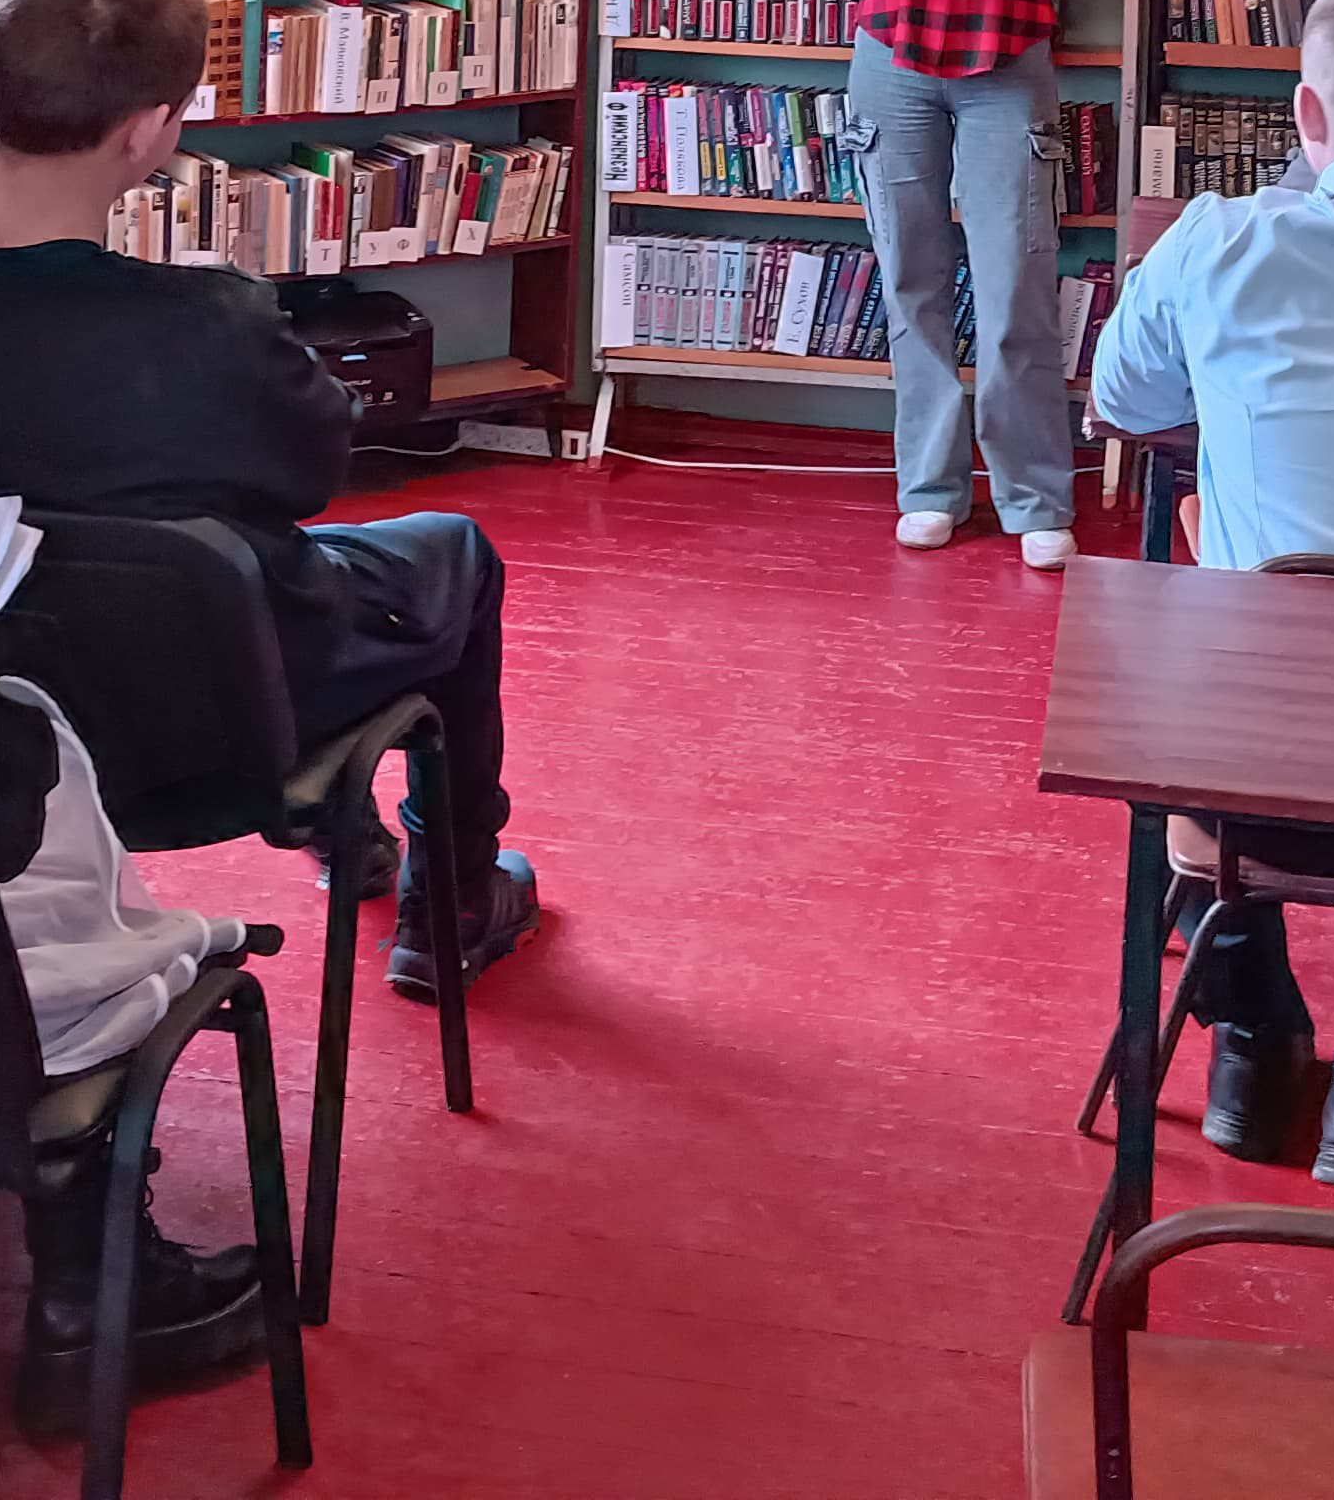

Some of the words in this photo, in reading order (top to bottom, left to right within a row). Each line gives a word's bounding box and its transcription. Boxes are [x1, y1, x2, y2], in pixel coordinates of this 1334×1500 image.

[334, 27, 351, 105] Маяковский
[606, 102, 629, 111] Ф
[604, 114, 629, 182] Незнанский
